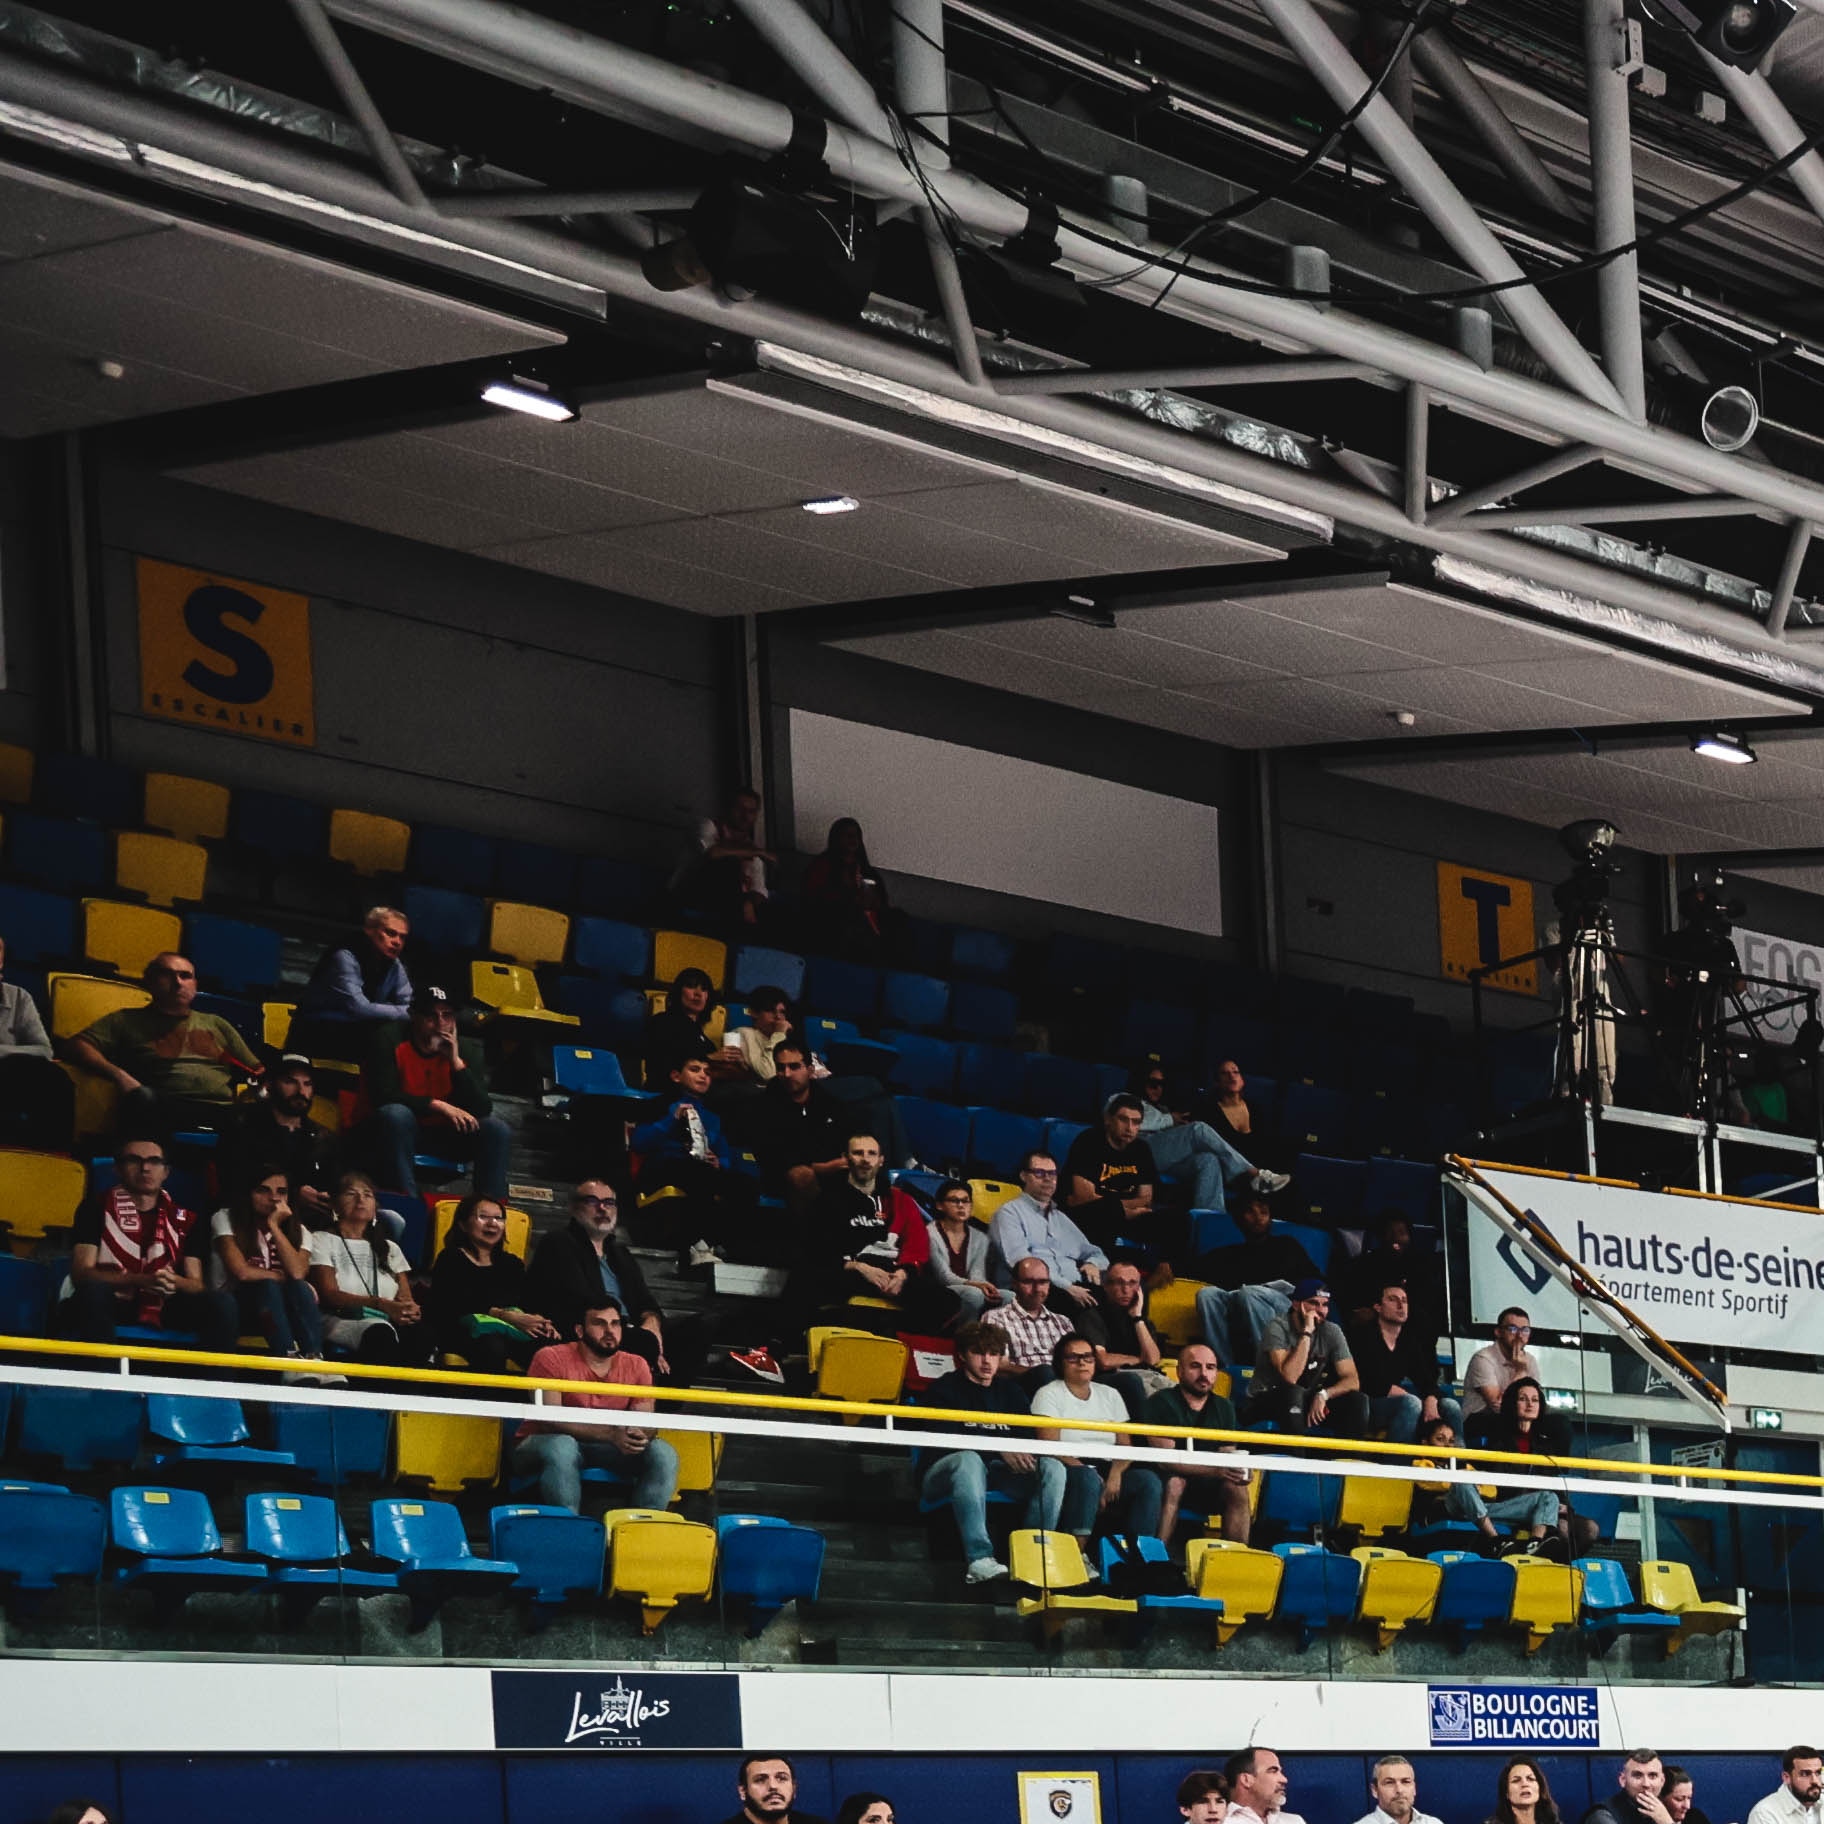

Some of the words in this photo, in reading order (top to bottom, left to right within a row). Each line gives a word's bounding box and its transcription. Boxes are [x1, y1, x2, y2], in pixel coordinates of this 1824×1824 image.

[181, 585, 274, 705] S
[1460, 876, 1512, 966] T
[1721, 1289, 1789, 1320] Sportif
[564, 1689, 671, 1743] Levallois
[1472, 1693, 1597, 1716] BOULOGNE-
[1474, 1718, 1600, 1740] BILLANCOURT
